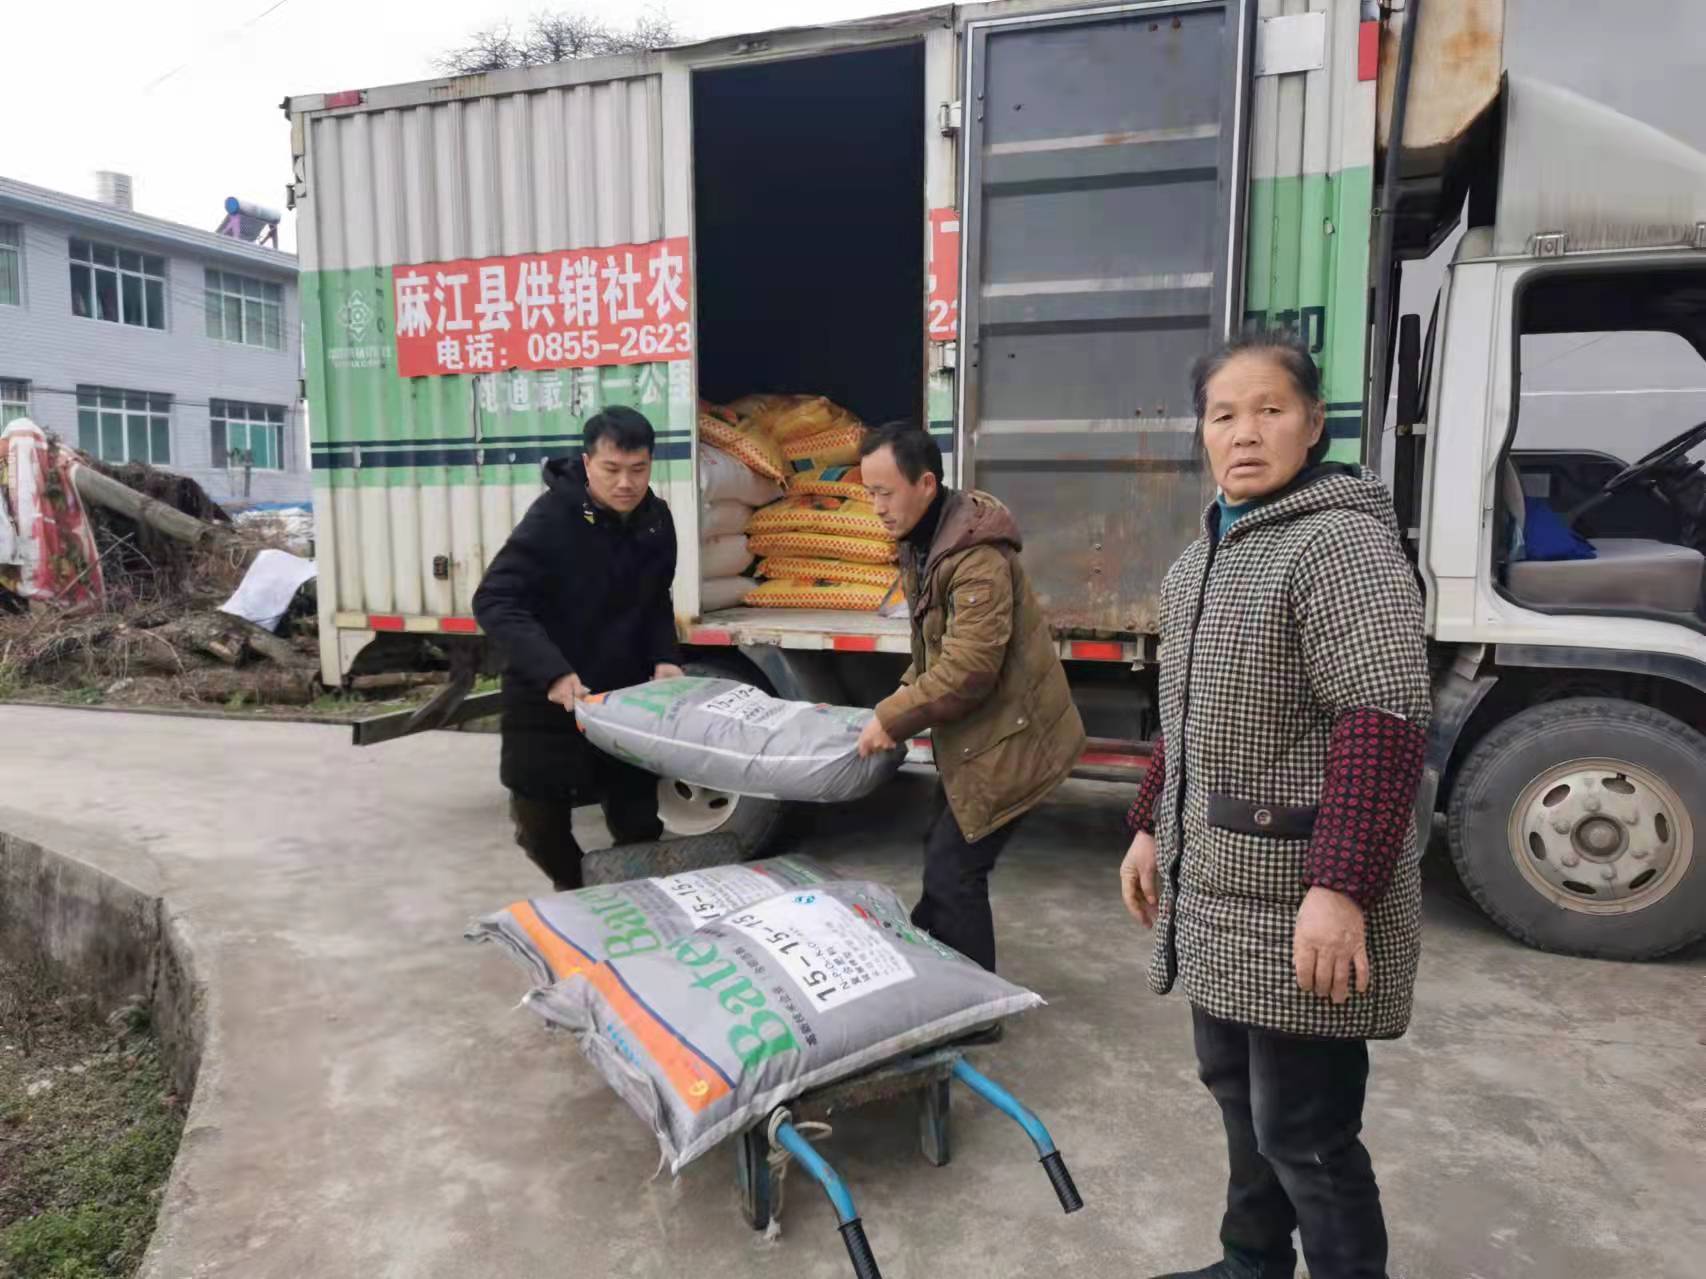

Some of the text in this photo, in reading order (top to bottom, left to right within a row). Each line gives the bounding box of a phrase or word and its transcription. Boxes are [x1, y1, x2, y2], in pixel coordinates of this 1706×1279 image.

[396, 247, 689, 338] 麻江县供销社农
[527, 322, 691, 362] 0855-2623
[731, 914, 837, 1002] 15-15-15
